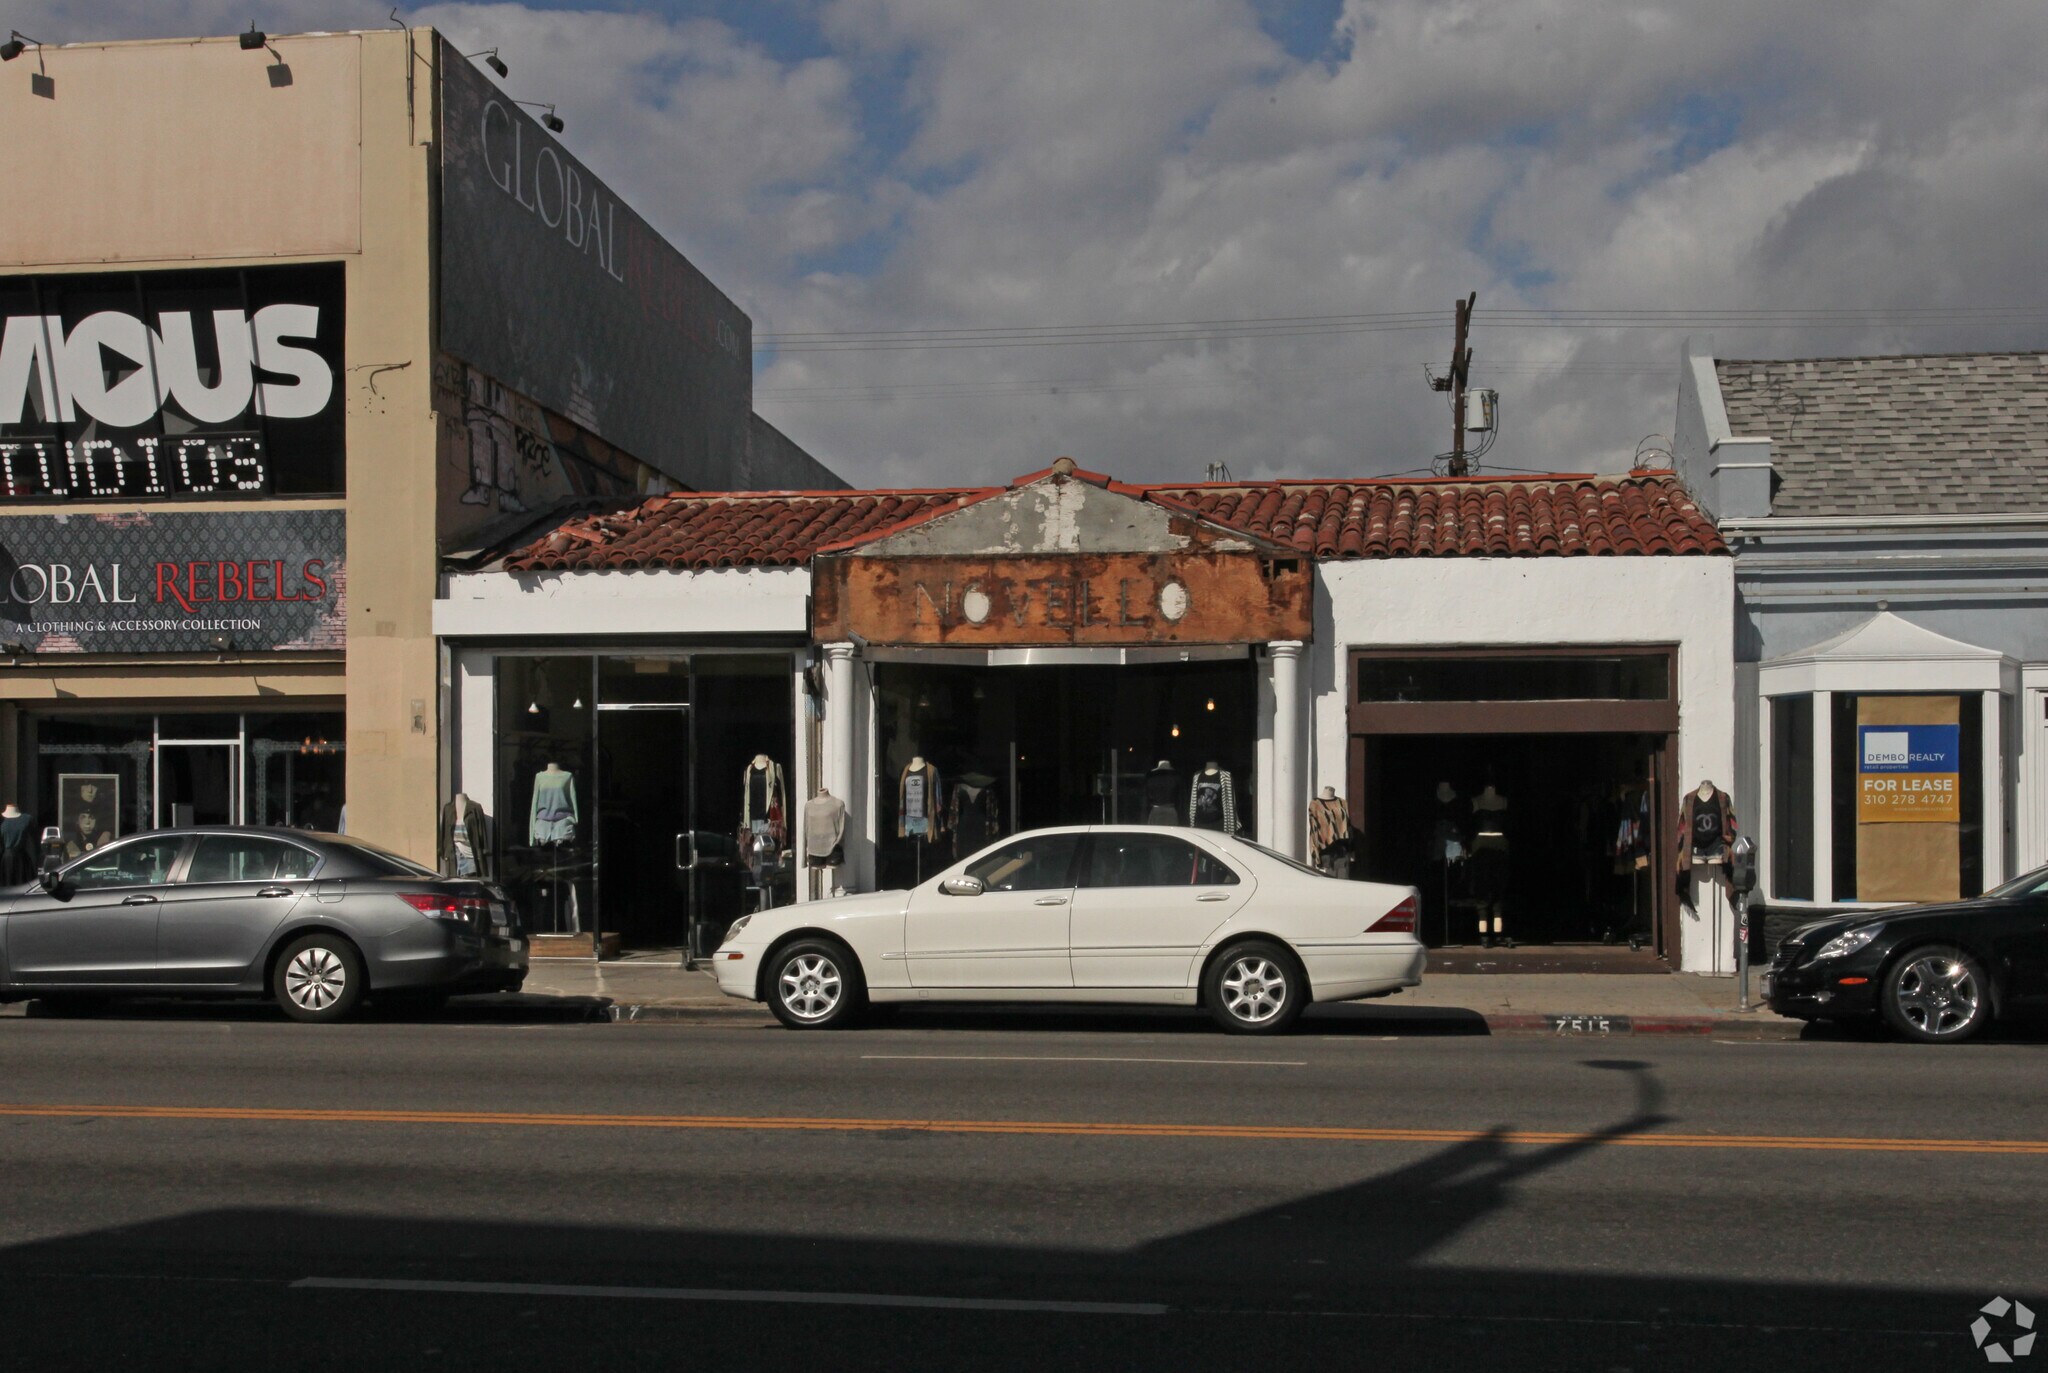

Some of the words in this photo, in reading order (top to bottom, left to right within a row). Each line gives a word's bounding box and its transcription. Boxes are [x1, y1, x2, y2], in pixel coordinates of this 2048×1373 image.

[481, 100, 624, 283] GLOBAL
[155, 559, 327, 613] REBELS
[915, 579, 1190, 627] NOVELLO
[15, 622, 24, 633] A
[27, 620, 94, 633] CLOTHING
[97, 620, 107, 631] &
[110, 619, 180, 631] ACCESSORY
[182, 618, 261, 631] COLLECTION
[1867, 753, 1906, 762] DEMBO
[1909, 753, 1945, 762] REALTY
[1864, 779, 1897, 791] FOR
[1902, 779, 1953, 791] LEASE
[1864, 794, 1886, 805] 310
[1892, 794, 1916, 805] 278
[1921, 794, 1953, 805] 4747
[1556, 1019, 1610, 1033] 7515
